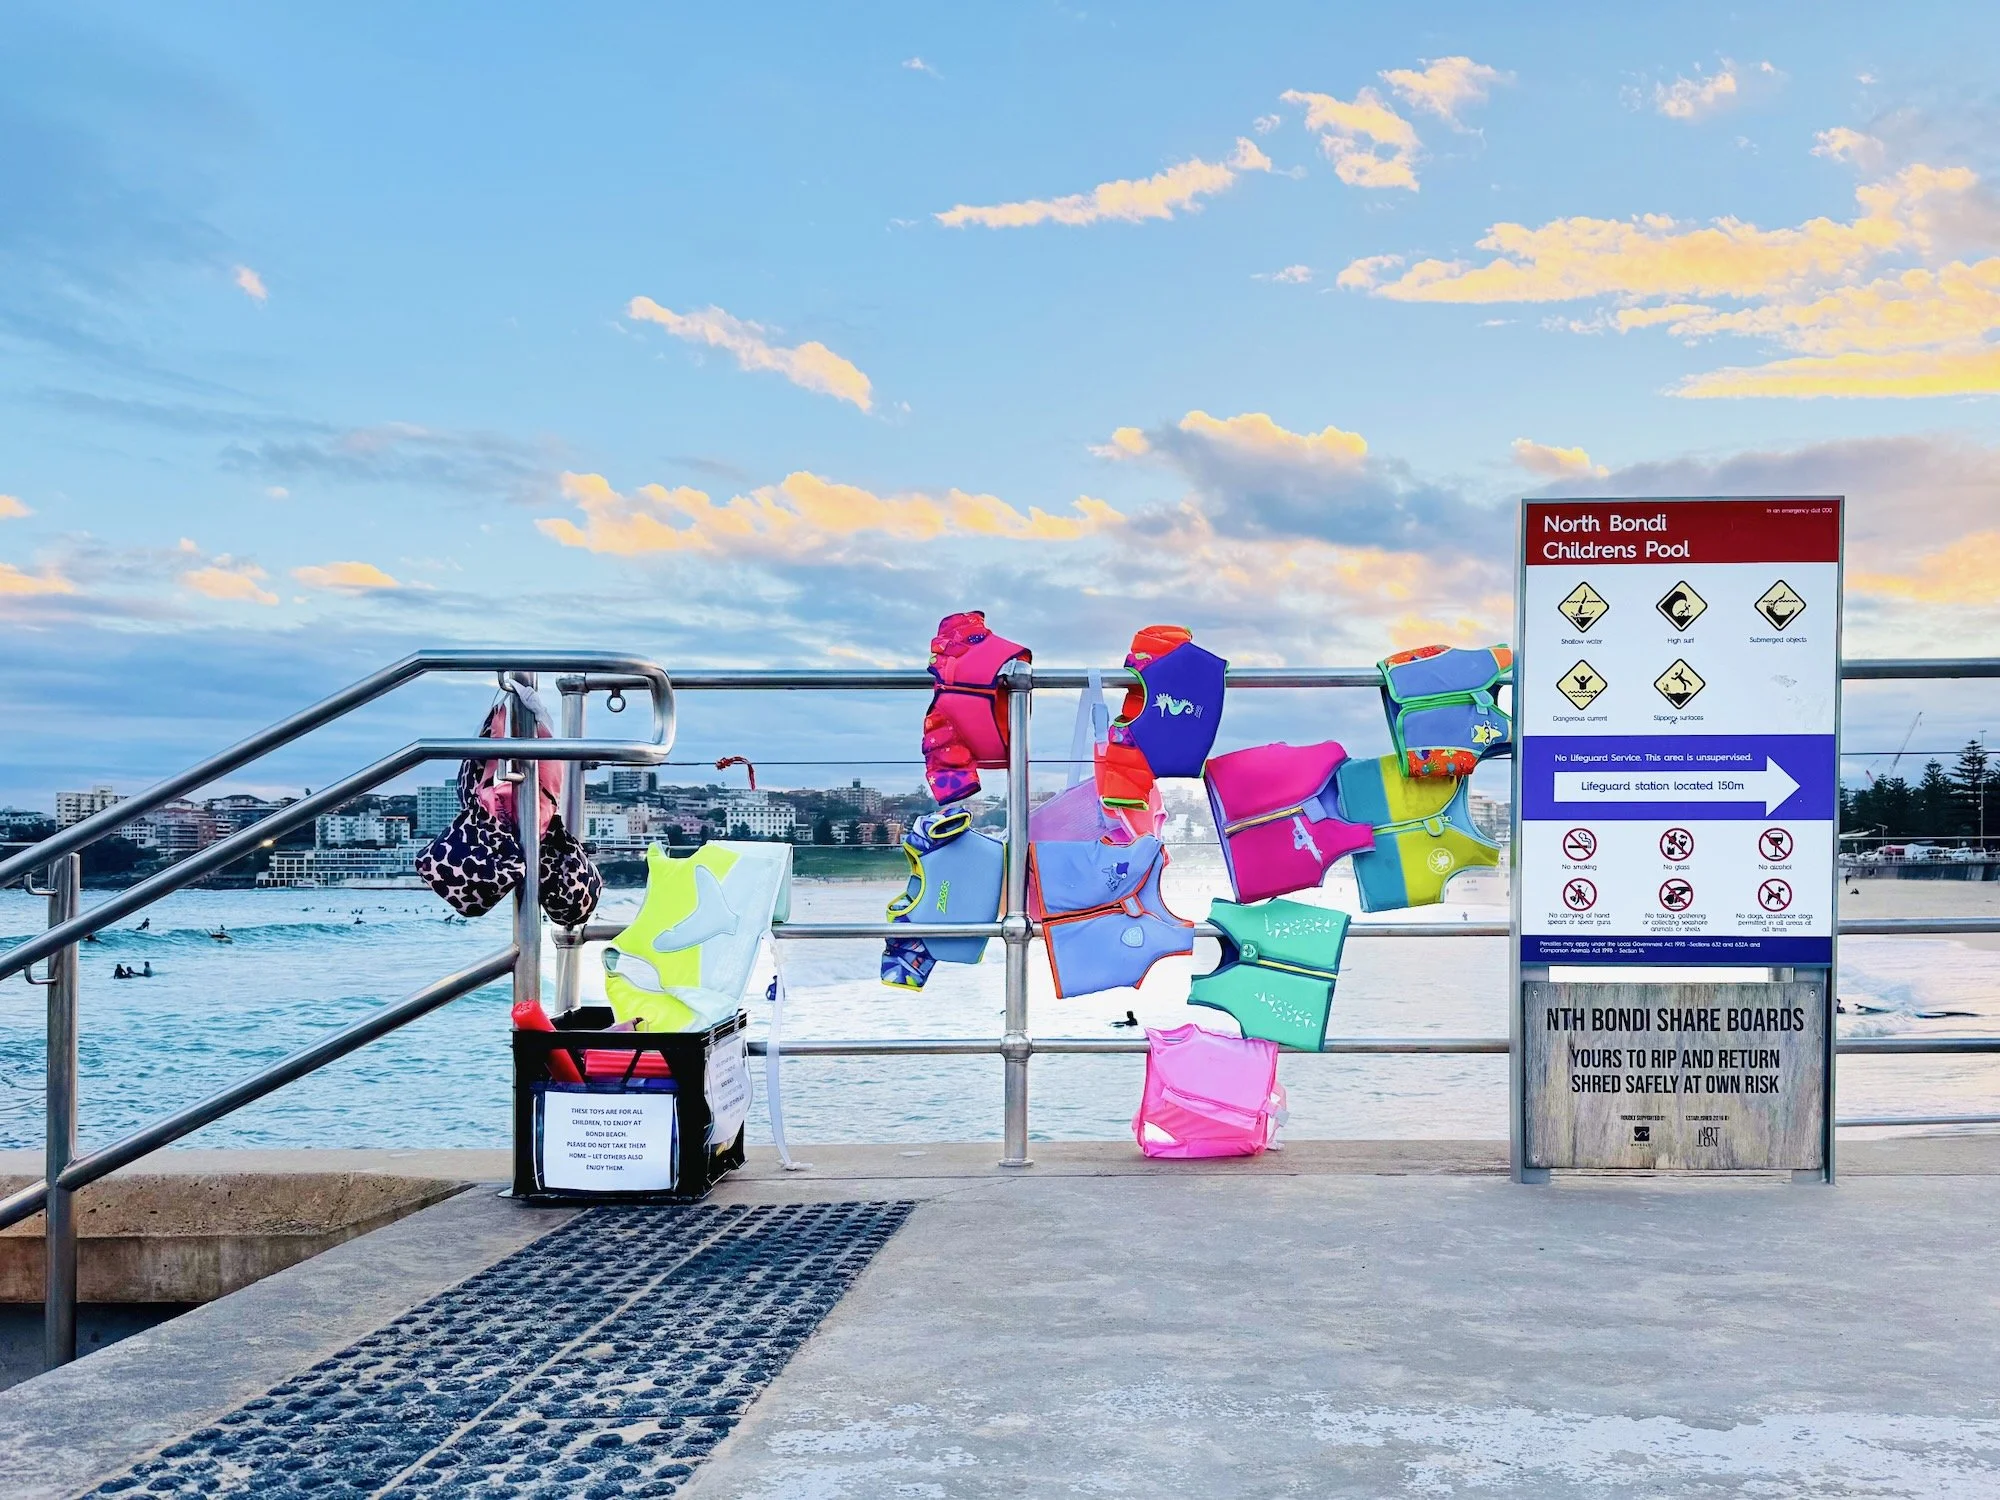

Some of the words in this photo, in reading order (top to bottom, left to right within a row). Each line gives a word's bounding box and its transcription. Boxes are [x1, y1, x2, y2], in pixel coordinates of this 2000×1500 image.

[1544, 515, 1600, 533] North
[1609, 514, 1667, 532] Bondi
[1543, 541, 1637, 559] Childrens
[1645, 540, 1690, 558] Pool
[1667, 637, 1681, 645] High
[1749, 636, 1784, 644] Submerged
[1786, 636, 1807, 644] objects
[1653, 714, 1677, 722] Slippery
[1554, 754, 1567, 762] No
[1570, 753, 1608, 763] Lifeguard
[1611, 754, 1642, 762] Service.
[1645, 753, 1661, 761] This
[1686, 753, 1693, 761] is
[1696, 753, 1753, 763] unsupervised.
[1581, 781, 1631, 793] Lifeguard
[1634, 781, 1669, 791] station
[1674, 781, 1713, 791] located
[1717, 781, 1744, 790] 150m
[936, 879, 950, 914] ZOGGS
[1678, 912, 1707, 920] gathering
[1547, 1007, 1585, 1031] NTH
[1592, 1008, 1651, 1032] BONDI
[1657, 1008, 1721, 1032] SHARE
[1727, 1008, 1805, 1032] BOARDS
[1571, 1049, 1622, 1069] YOURS
[1627, 1049, 1647, 1069] TO
[1651, 1049, 1677, 1068] RIP
[1682, 1049, 1714, 1068] AND
[1718, 1049, 1780, 1069] RETURN
[1571, 1075, 1621, 1094] SHRED
[1625, 1075, 1679, 1094] SAFELY
[1683, 1075, 1701, 1094] AT
[1705, 1075, 1740, 1094] OWN
[1745, 1075, 1780, 1094] RISK
[572, 1119, 602, 1127] CHILDREN,
